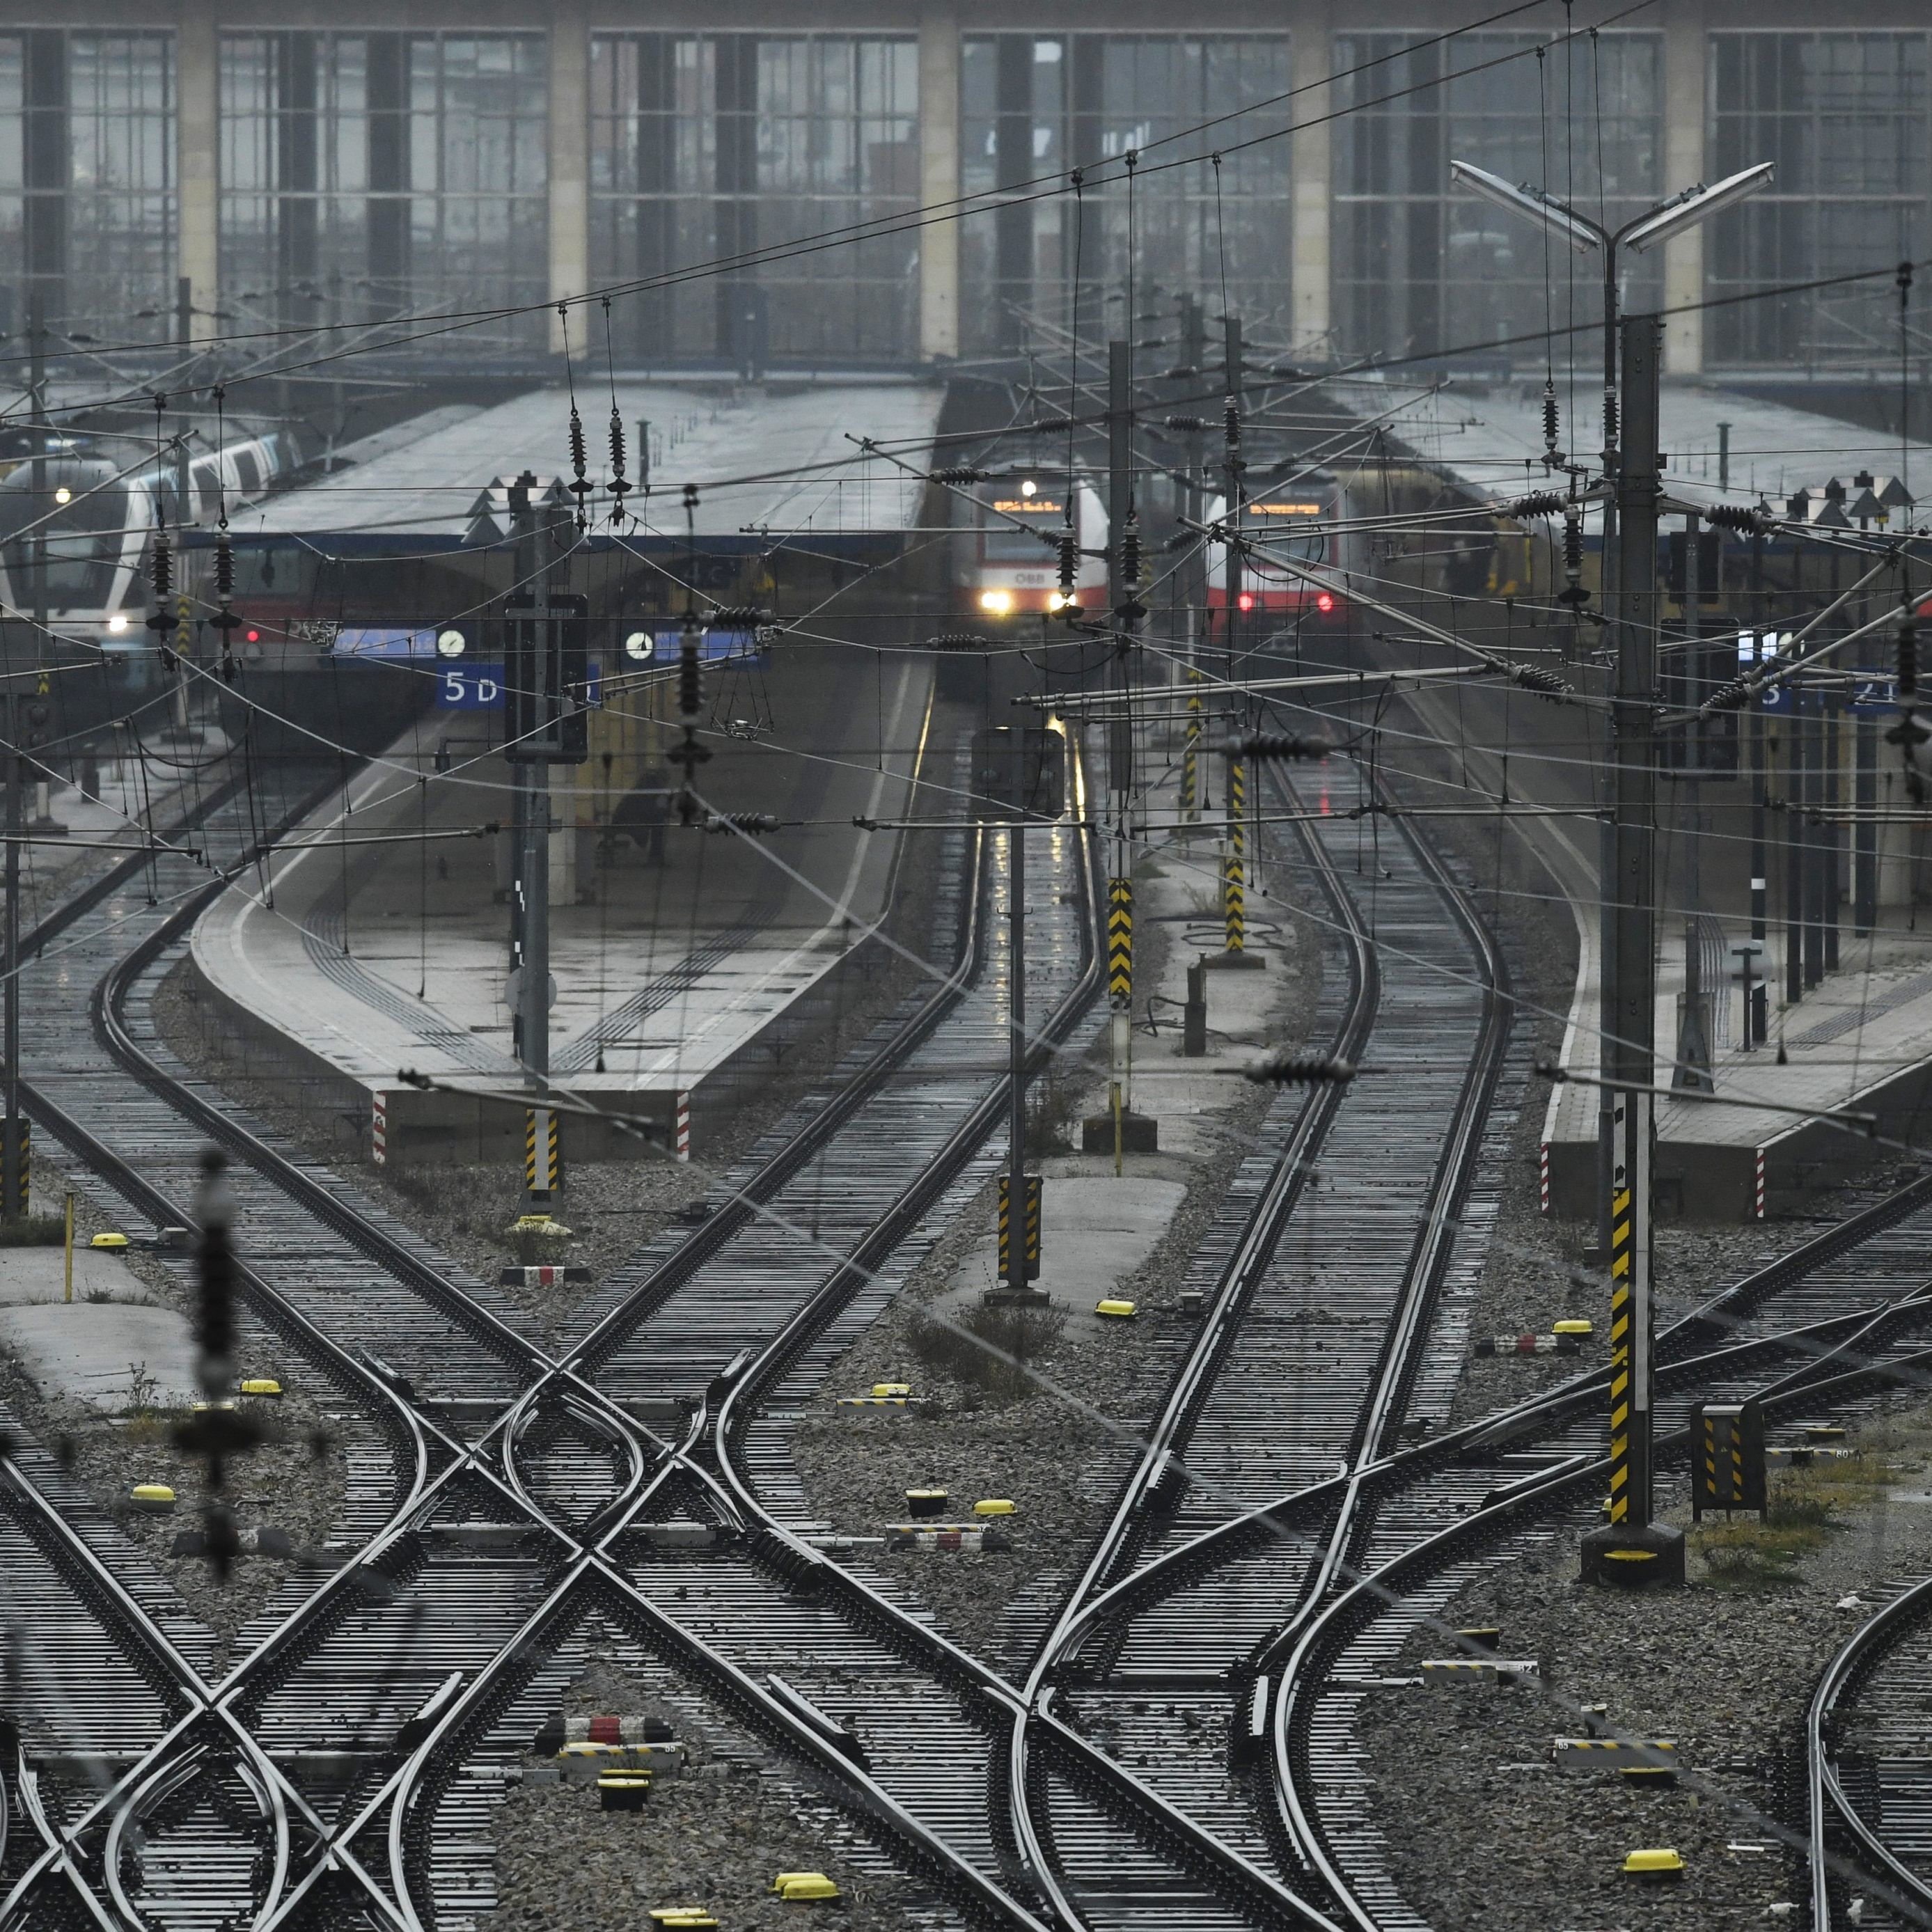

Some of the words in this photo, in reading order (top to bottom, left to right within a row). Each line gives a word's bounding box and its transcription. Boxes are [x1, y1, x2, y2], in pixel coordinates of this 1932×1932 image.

[446, 672, 465, 701] 5
[478, 679, 497, 702] D
[1836, 1450, 1848, 1459] 80
[1518, 1664, 1532, 1674] 82
[665, 1745, 675, 1753] 55
[1558, 1741, 1569, 1750] 65
